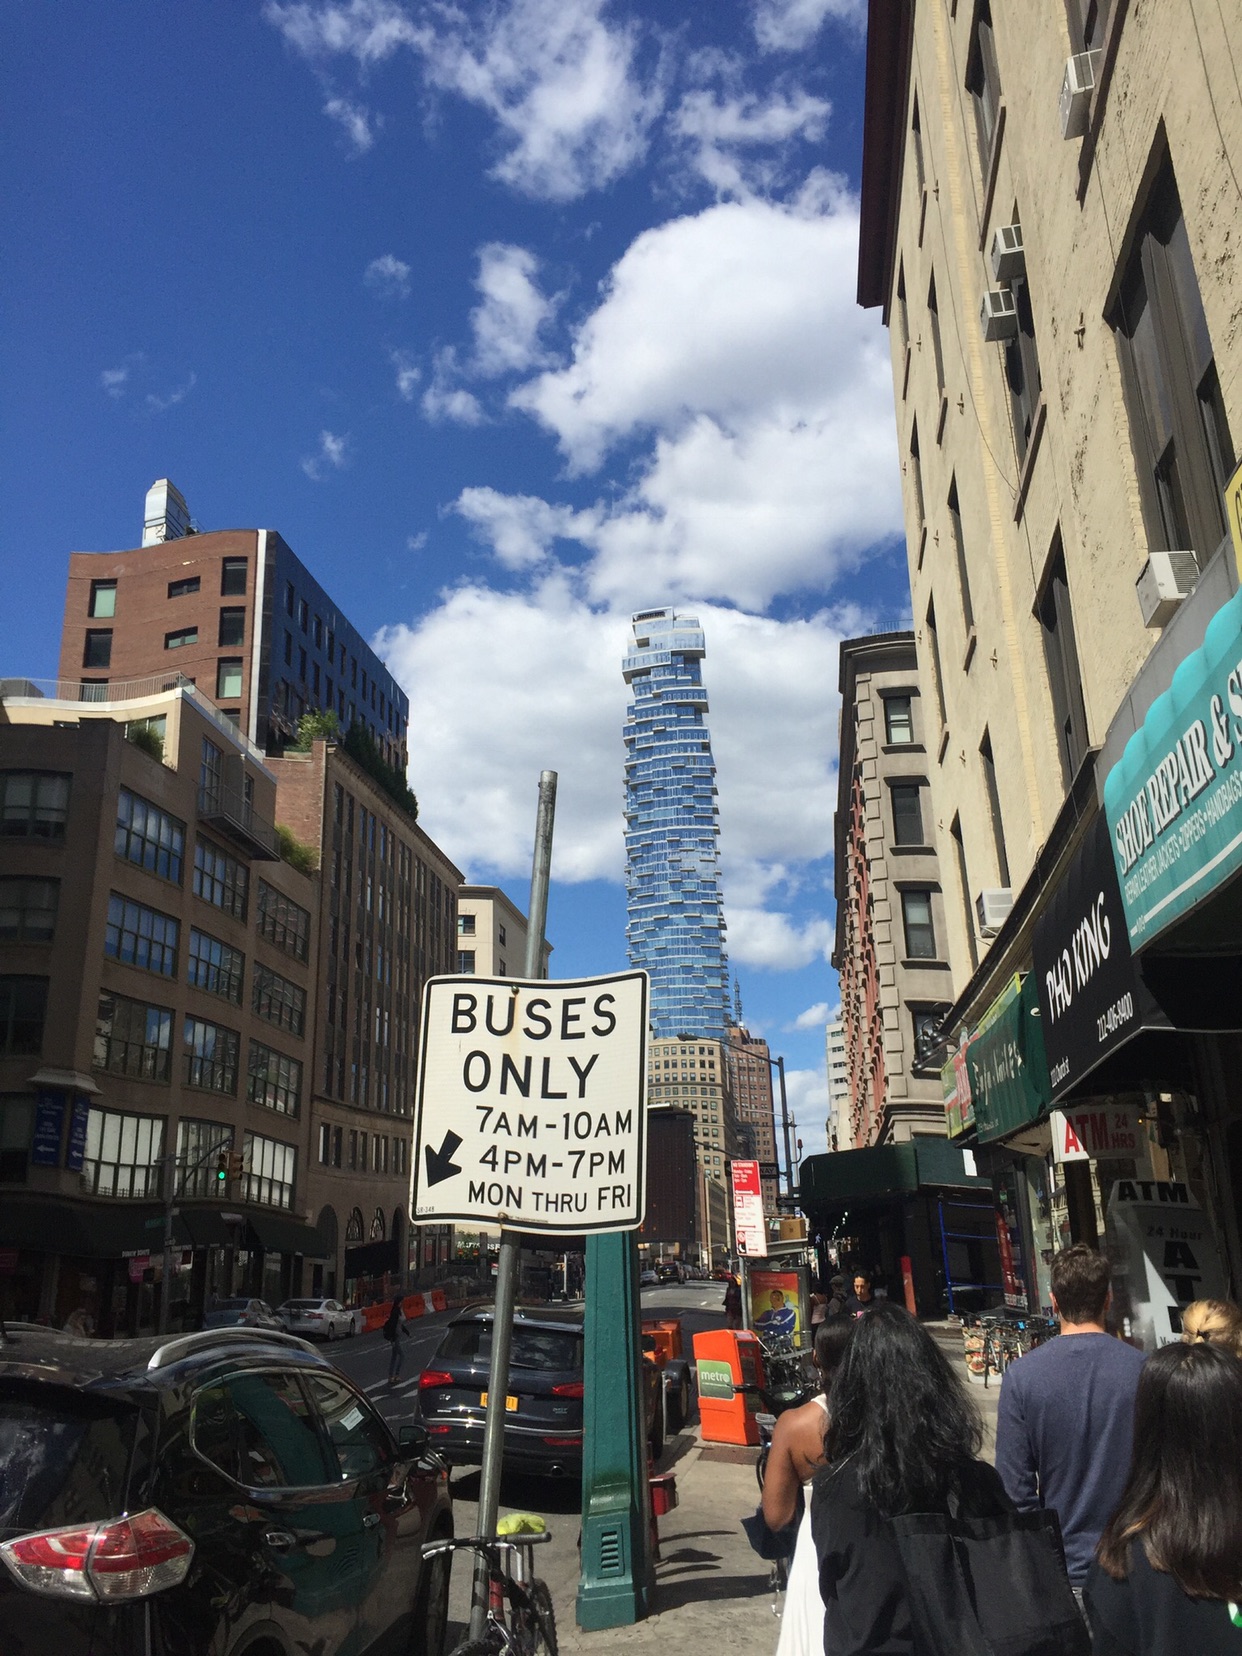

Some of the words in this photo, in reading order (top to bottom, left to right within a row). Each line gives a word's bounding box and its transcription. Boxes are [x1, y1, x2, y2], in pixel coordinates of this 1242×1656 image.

[1115, 790, 1152, 876] SHOE
[1147, 719, 1215, 838] REPAIR
[1210, 694, 1230, 768] &
[1156, 833, 1181, 875] JACKETS
[1179, 809, 1206, 852] ZIPPERS
[1205, 769, 1241, 828] HANDBAGS
[1046, 949, 1072, 1025] PHO
[1072, 891, 1111, 994] KING
[451, 993, 617, 1040] BUSES
[463, 1050, 600, 1099] ONLY
[476, 1105, 632, 1140] 7AM-10AM
[1065, 1112, 1109, 1153] ATM
[1115, 1113, 1128, 1129] 24
[1111, 1132, 1136, 1149] HRS
[479, 1144, 625, 1178] 4PM-7PM
[468, 1180, 522, 1209] MON
[532, 1191, 587, 1212] THRU
[598, 1184, 631, 1211] FRI
[1118, 1181, 1189, 1203] ATM
[1147, 1225, 1164, 1238] 24
[1170, 1227, 1202, 1240] Hour
[701, 1371, 731, 1383] metro
